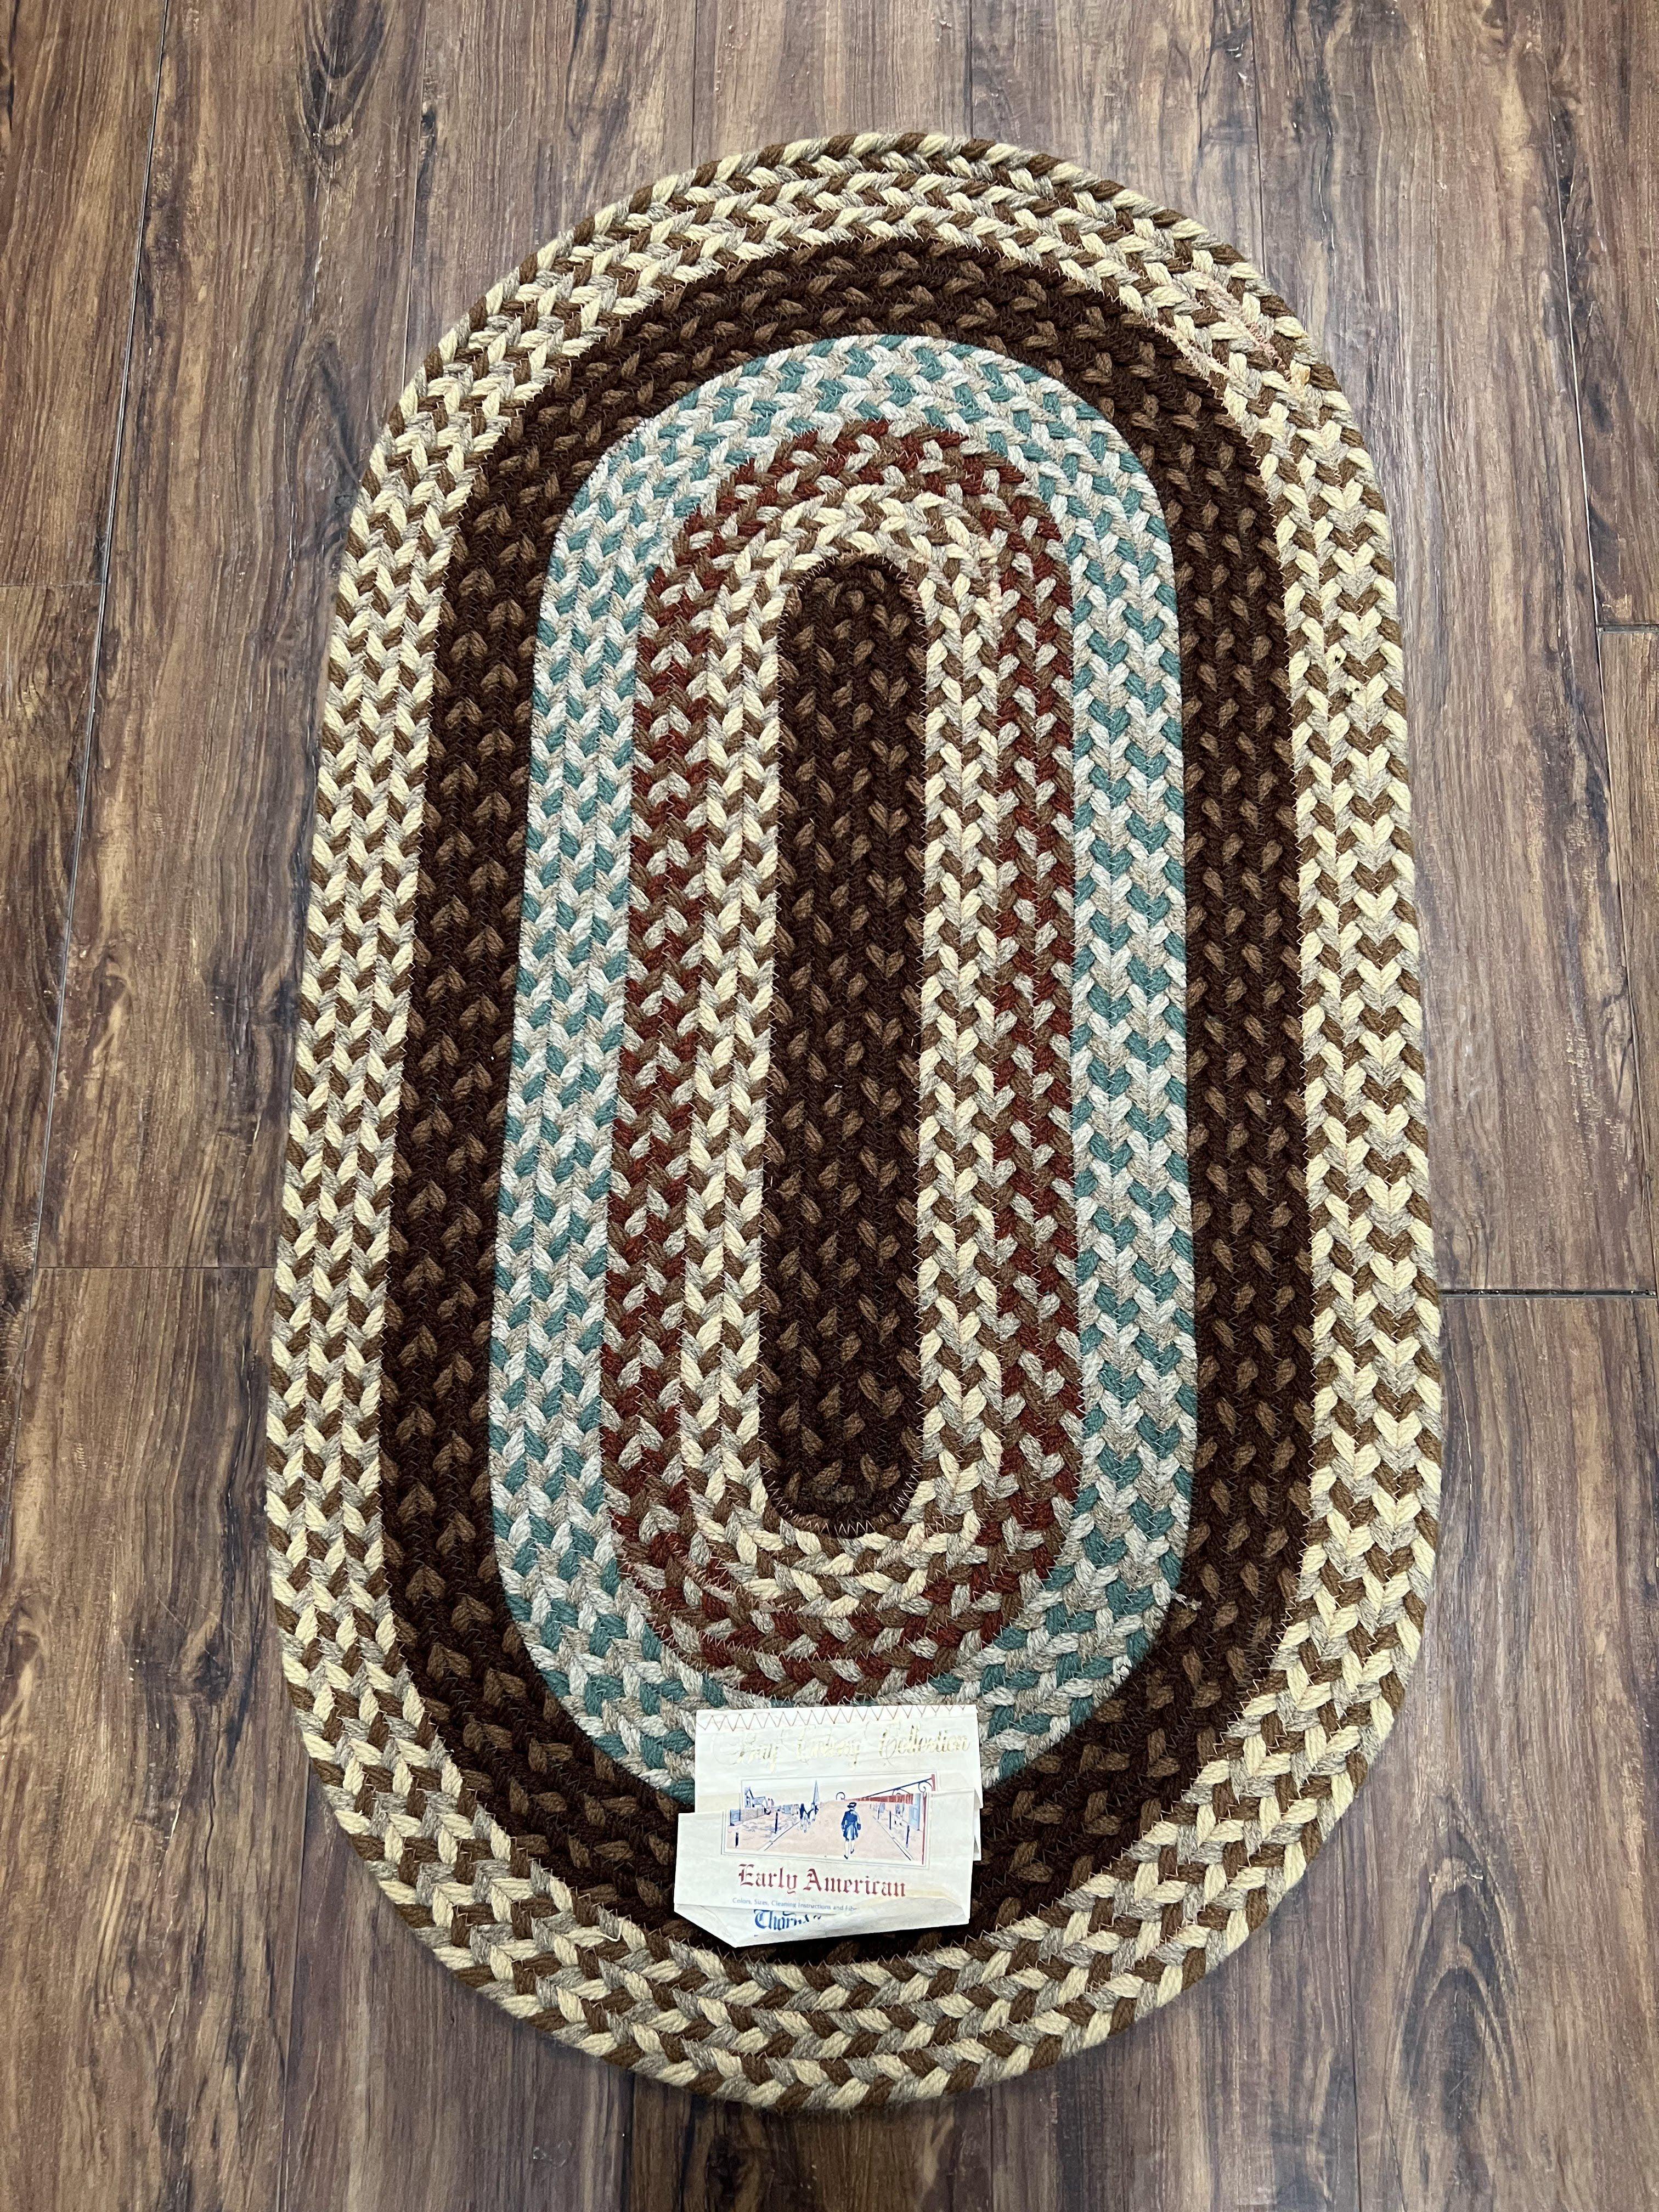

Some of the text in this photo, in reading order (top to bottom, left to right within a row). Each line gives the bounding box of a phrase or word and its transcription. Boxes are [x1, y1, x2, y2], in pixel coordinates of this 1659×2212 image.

[738, 1863, 906, 1897] Early American
[771, 1900, 795, 1909] Cleaning
